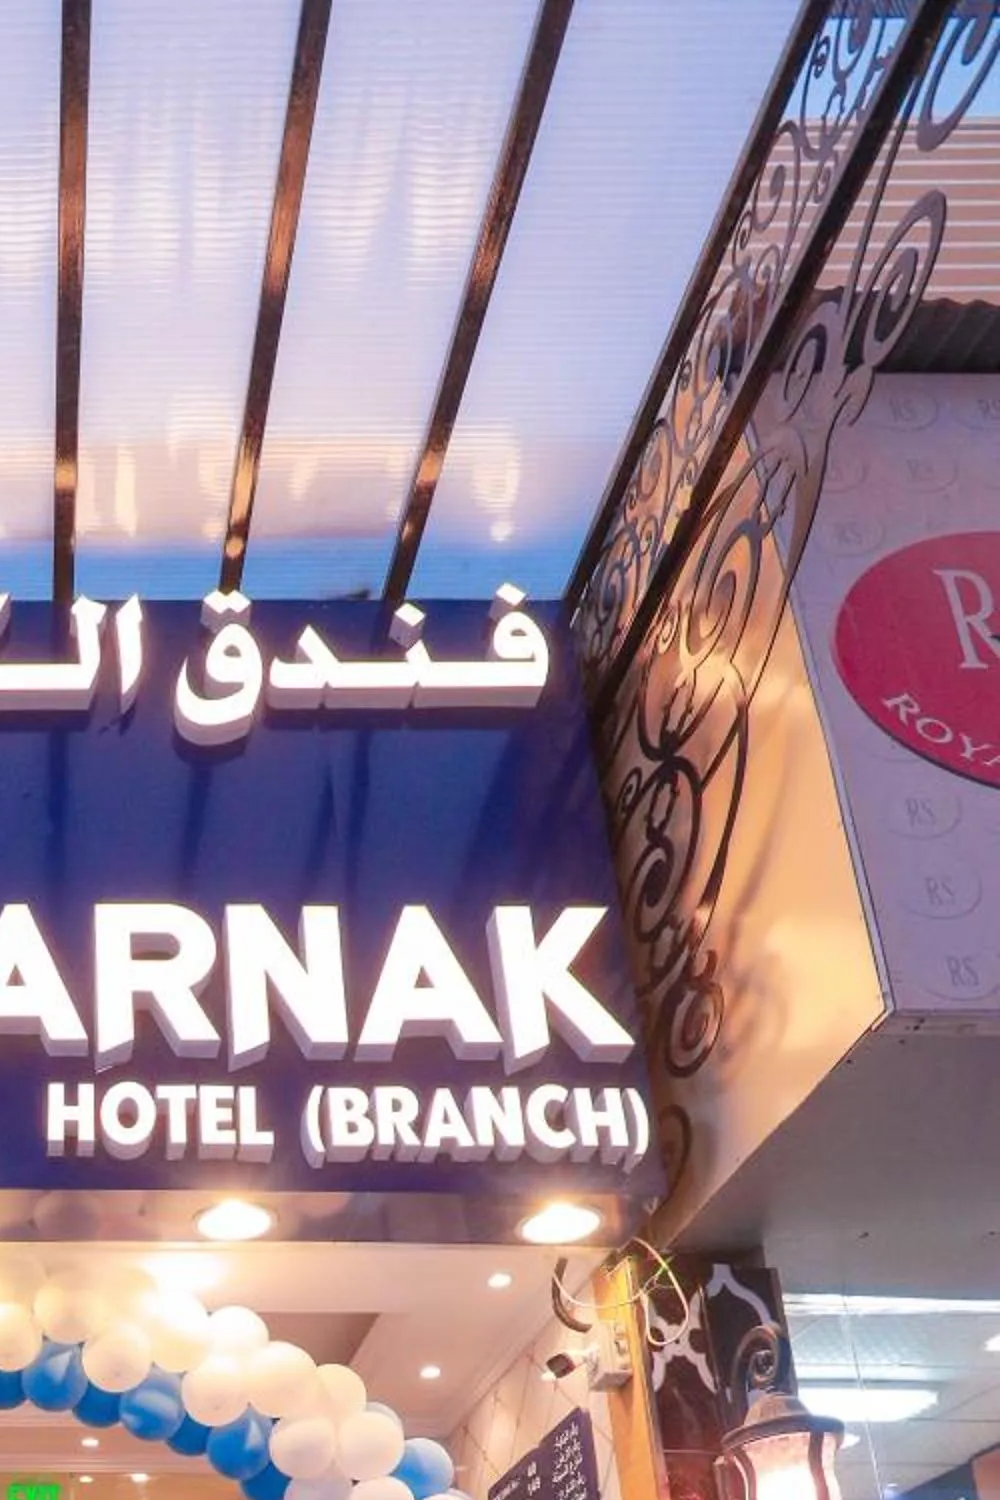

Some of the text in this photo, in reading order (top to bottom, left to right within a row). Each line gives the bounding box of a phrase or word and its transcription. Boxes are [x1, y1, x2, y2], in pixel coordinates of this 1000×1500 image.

[176, 583, 551, 744] فندق
[45, 1082, 652, 1167] HOTEL (BRANCH)
